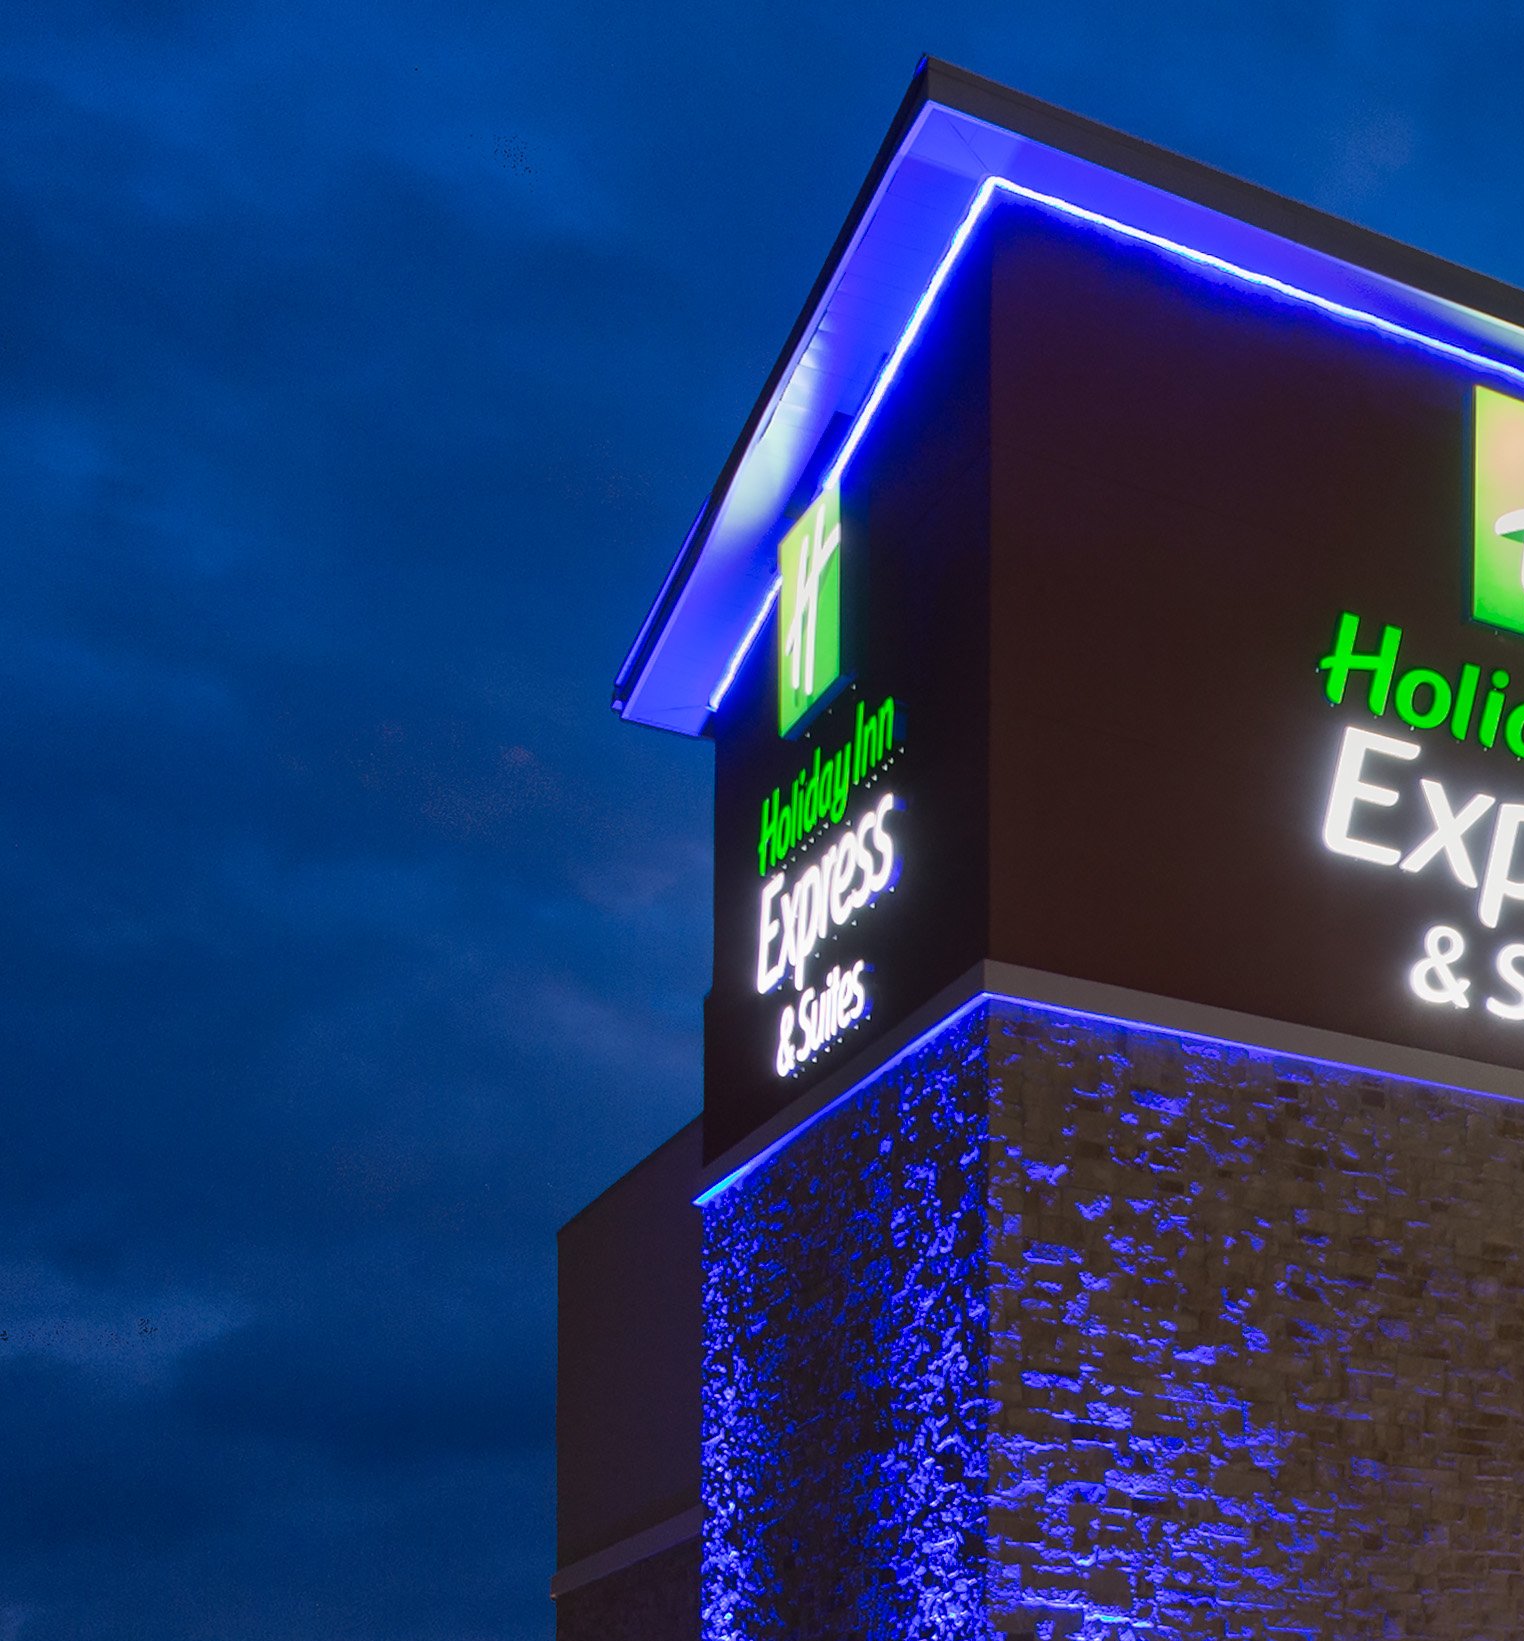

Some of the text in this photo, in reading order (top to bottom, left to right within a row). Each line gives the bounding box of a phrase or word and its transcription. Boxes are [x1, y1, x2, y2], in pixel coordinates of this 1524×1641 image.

[757, 696, 895, 878] Holiday Inn
[756, 792, 894, 995] Express
[1407, 924, 1473, 1011] &
[776, 959, 866, 1078] & Suites
